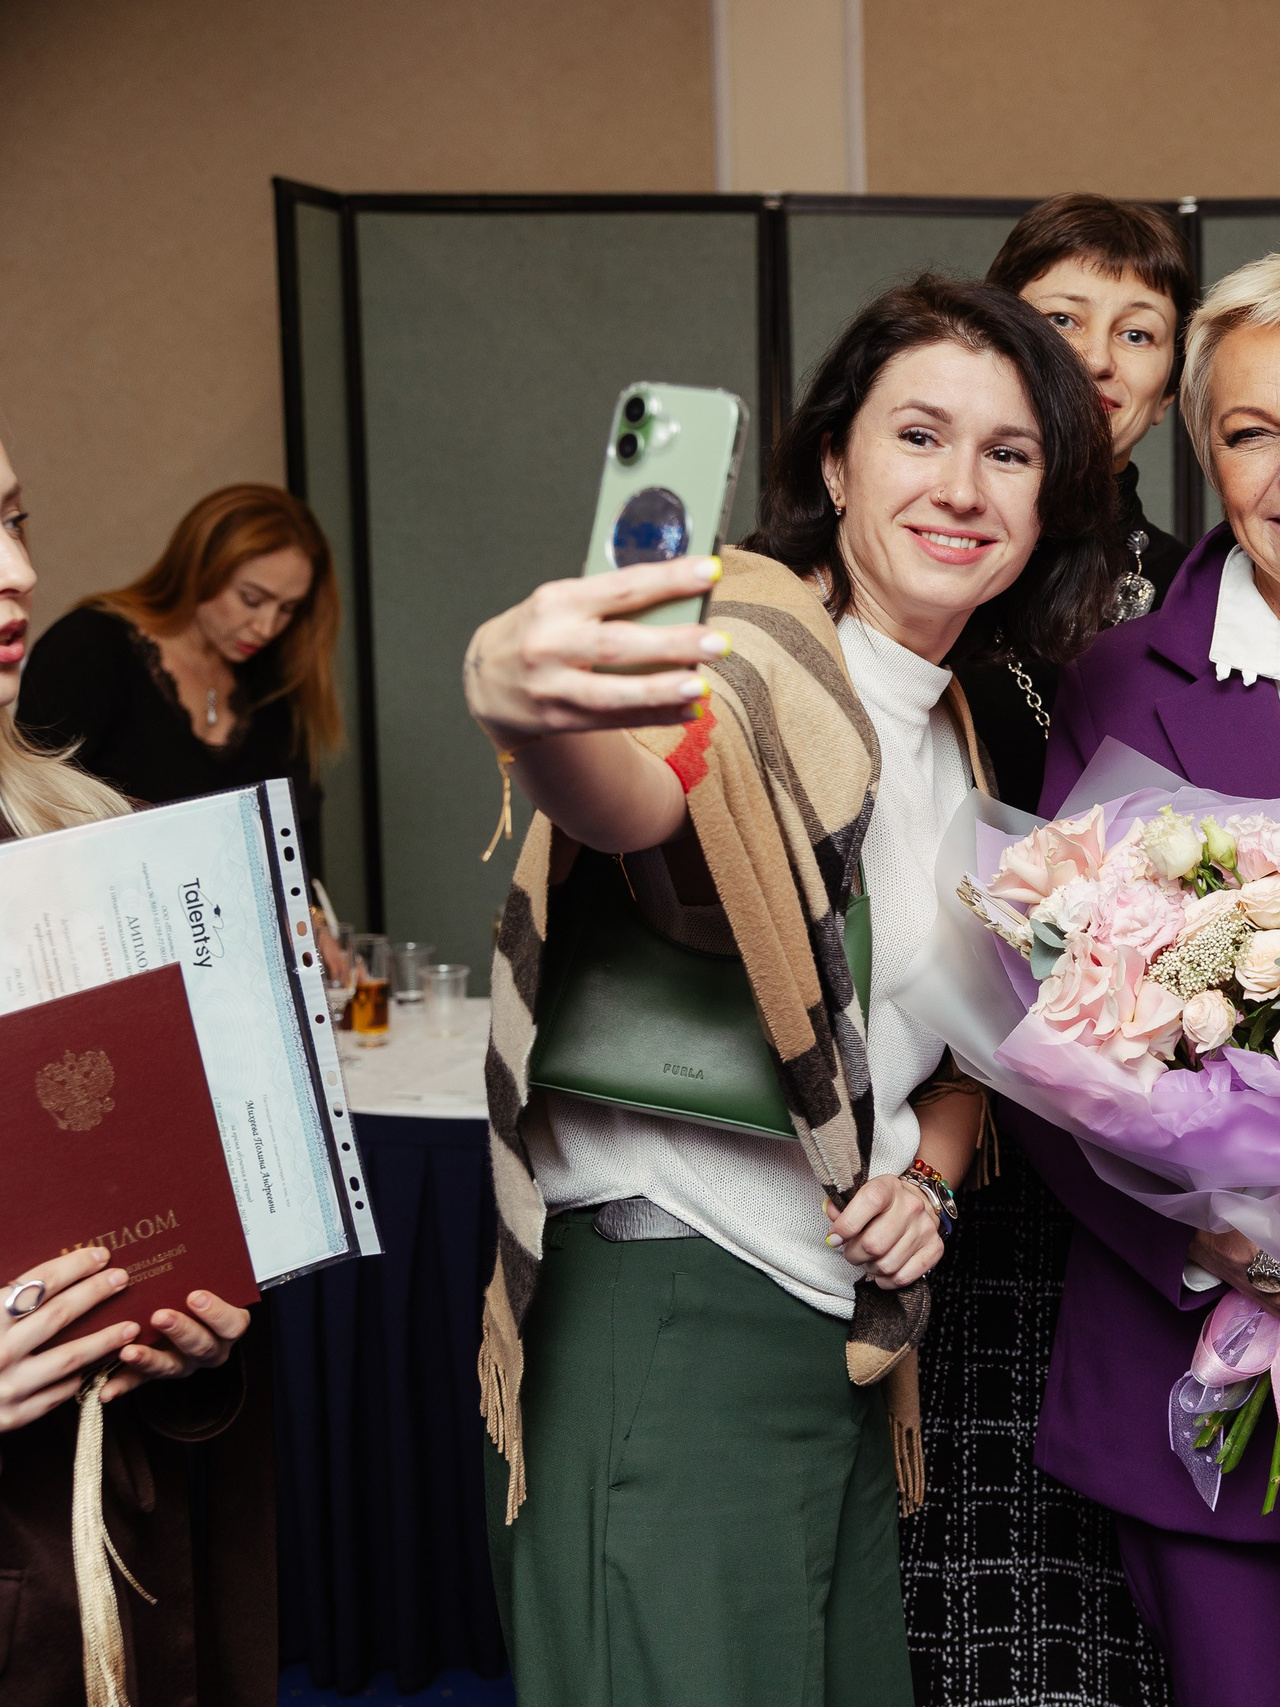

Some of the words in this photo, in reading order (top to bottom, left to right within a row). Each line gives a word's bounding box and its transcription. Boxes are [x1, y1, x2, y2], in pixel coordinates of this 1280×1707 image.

[126, 915, 149, 972] ДИПЛО
[183, 878, 213, 969] Talentsy
[662, 1063, 704, 1080] FURLA
[253, 1136, 268, 1170] Полина
[258, 1168, 278, 1214] Андреевна
[61, 1209, 181, 1256] ПЛОМ
